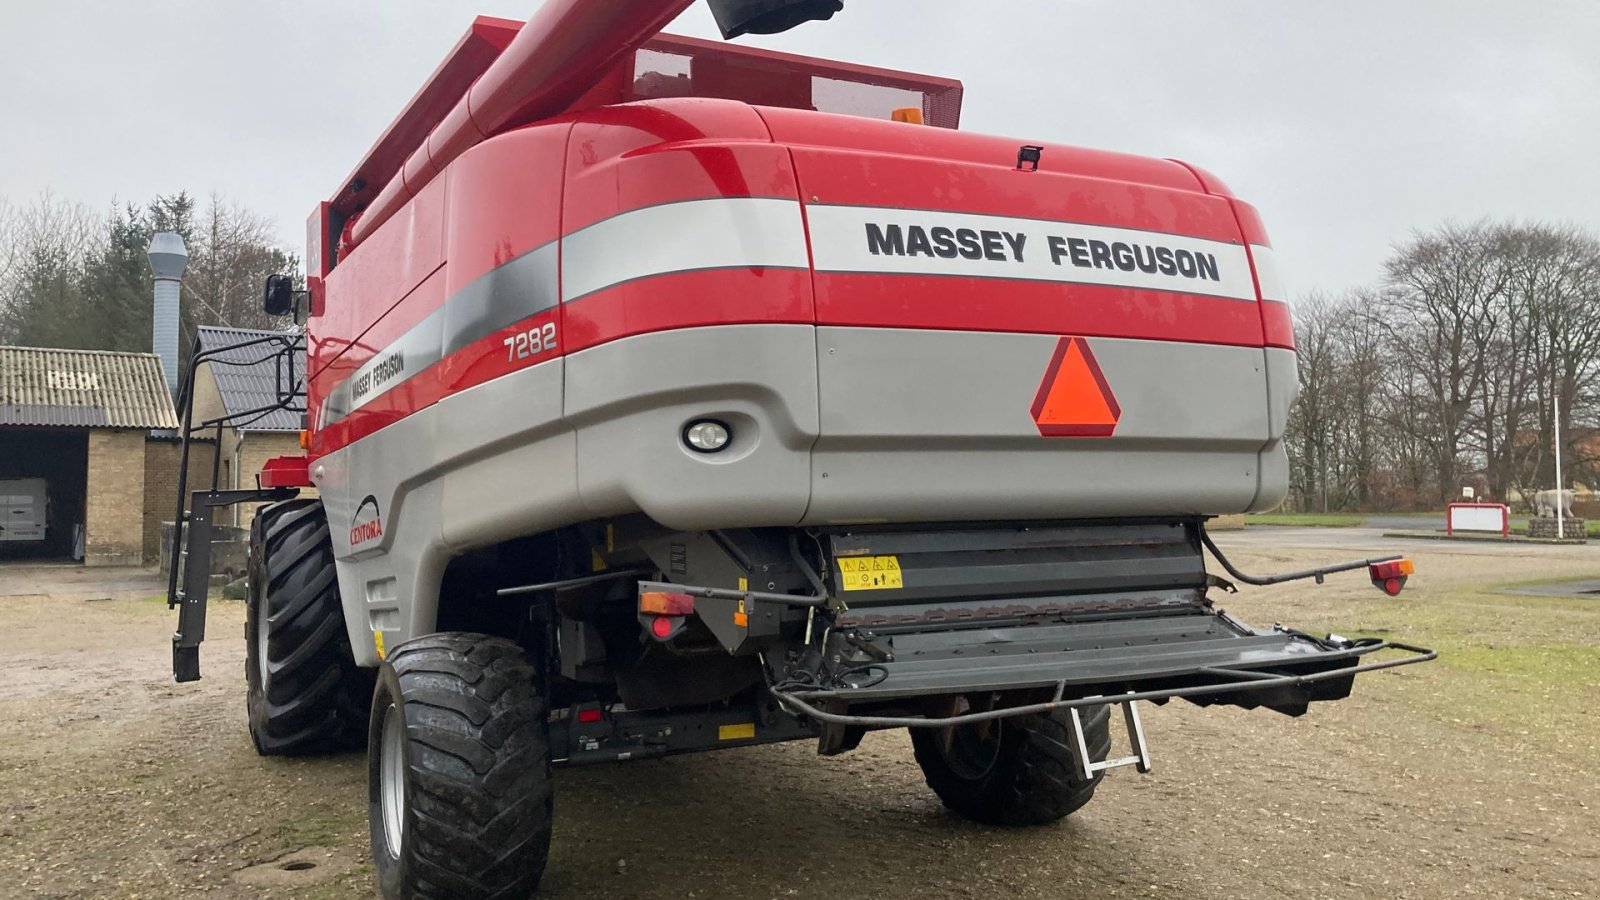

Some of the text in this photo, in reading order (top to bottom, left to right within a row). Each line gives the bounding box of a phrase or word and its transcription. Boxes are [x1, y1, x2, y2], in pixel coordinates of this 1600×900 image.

[865, 223, 1220, 282] MASSEY FERGUSON
[503, 322, 557, 363] 7282
[352, 349, 404, 401] MASSEY FERGUSON
[350, 518, 382, 546] CENTORA
